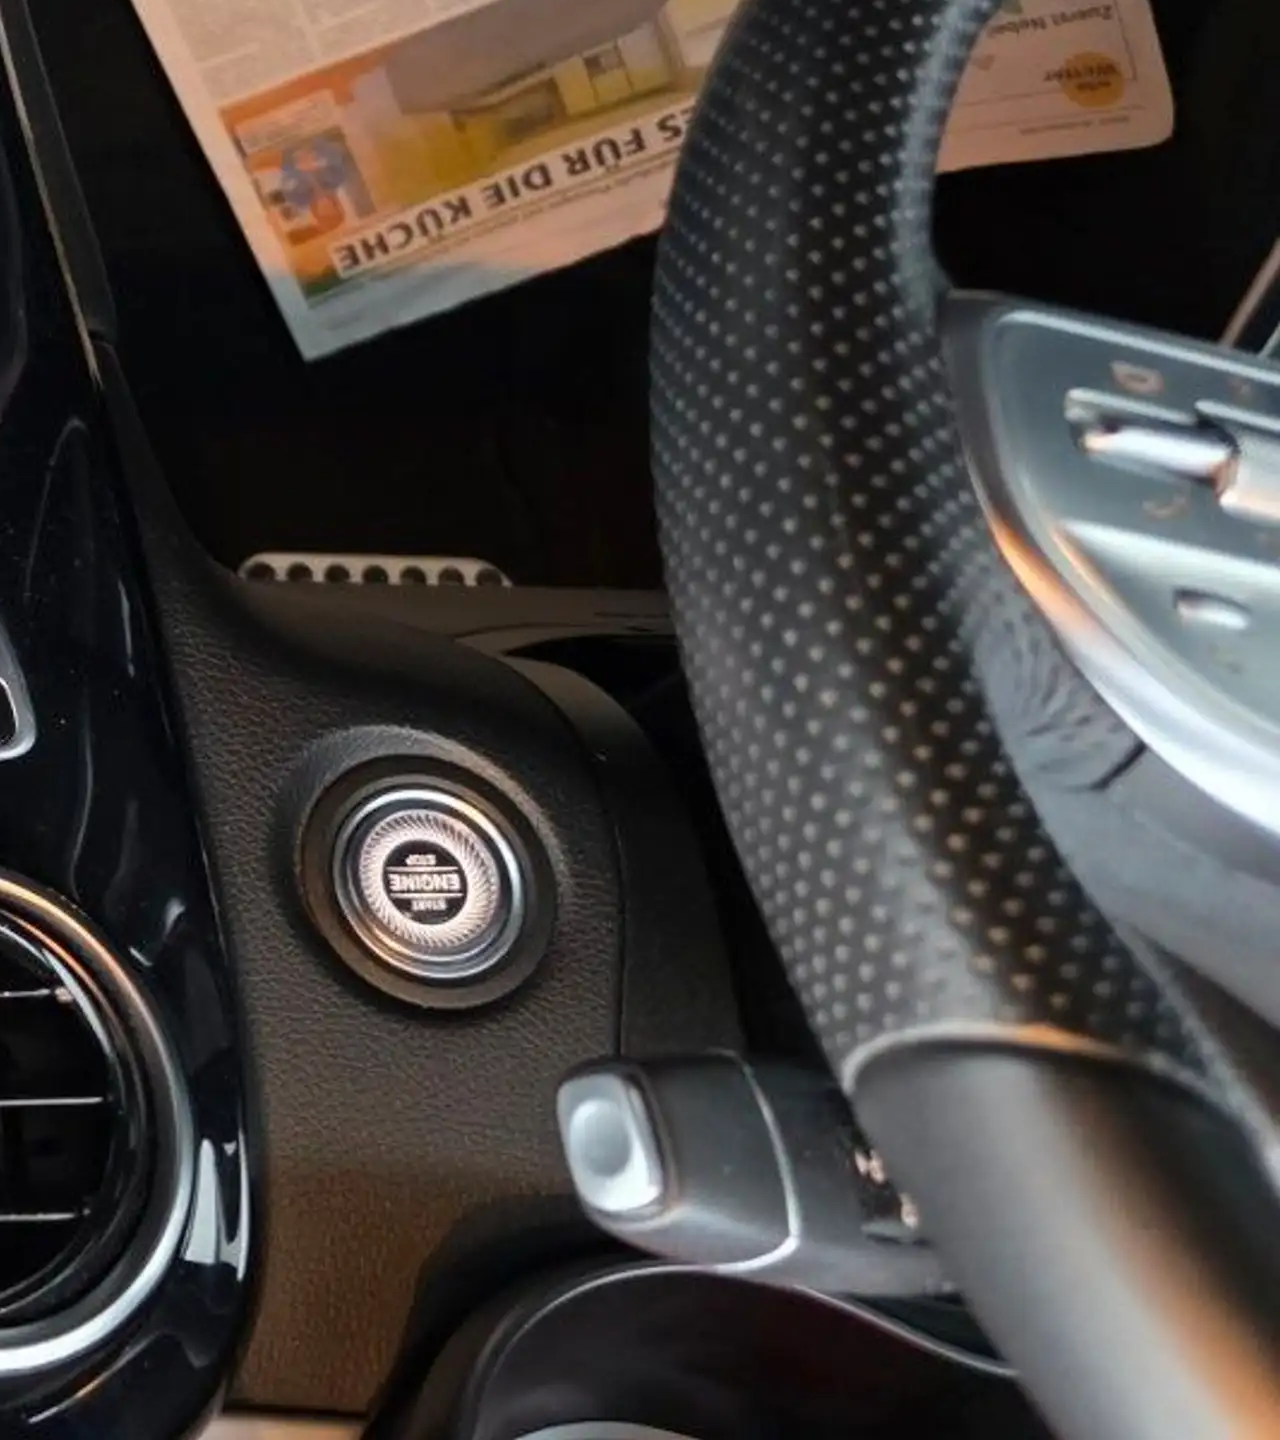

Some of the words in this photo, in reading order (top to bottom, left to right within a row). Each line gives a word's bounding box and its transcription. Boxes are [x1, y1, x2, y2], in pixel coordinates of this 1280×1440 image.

[562, 127, 646, 176] FÜR
[483, 163, 553, 206] DIE
[332, 195, 472, 272] KÜCHE
[405, 853, 436, 865] STOP
[387, 873, 461, 891] ENGINE
[410, 899, 447, 912] START
